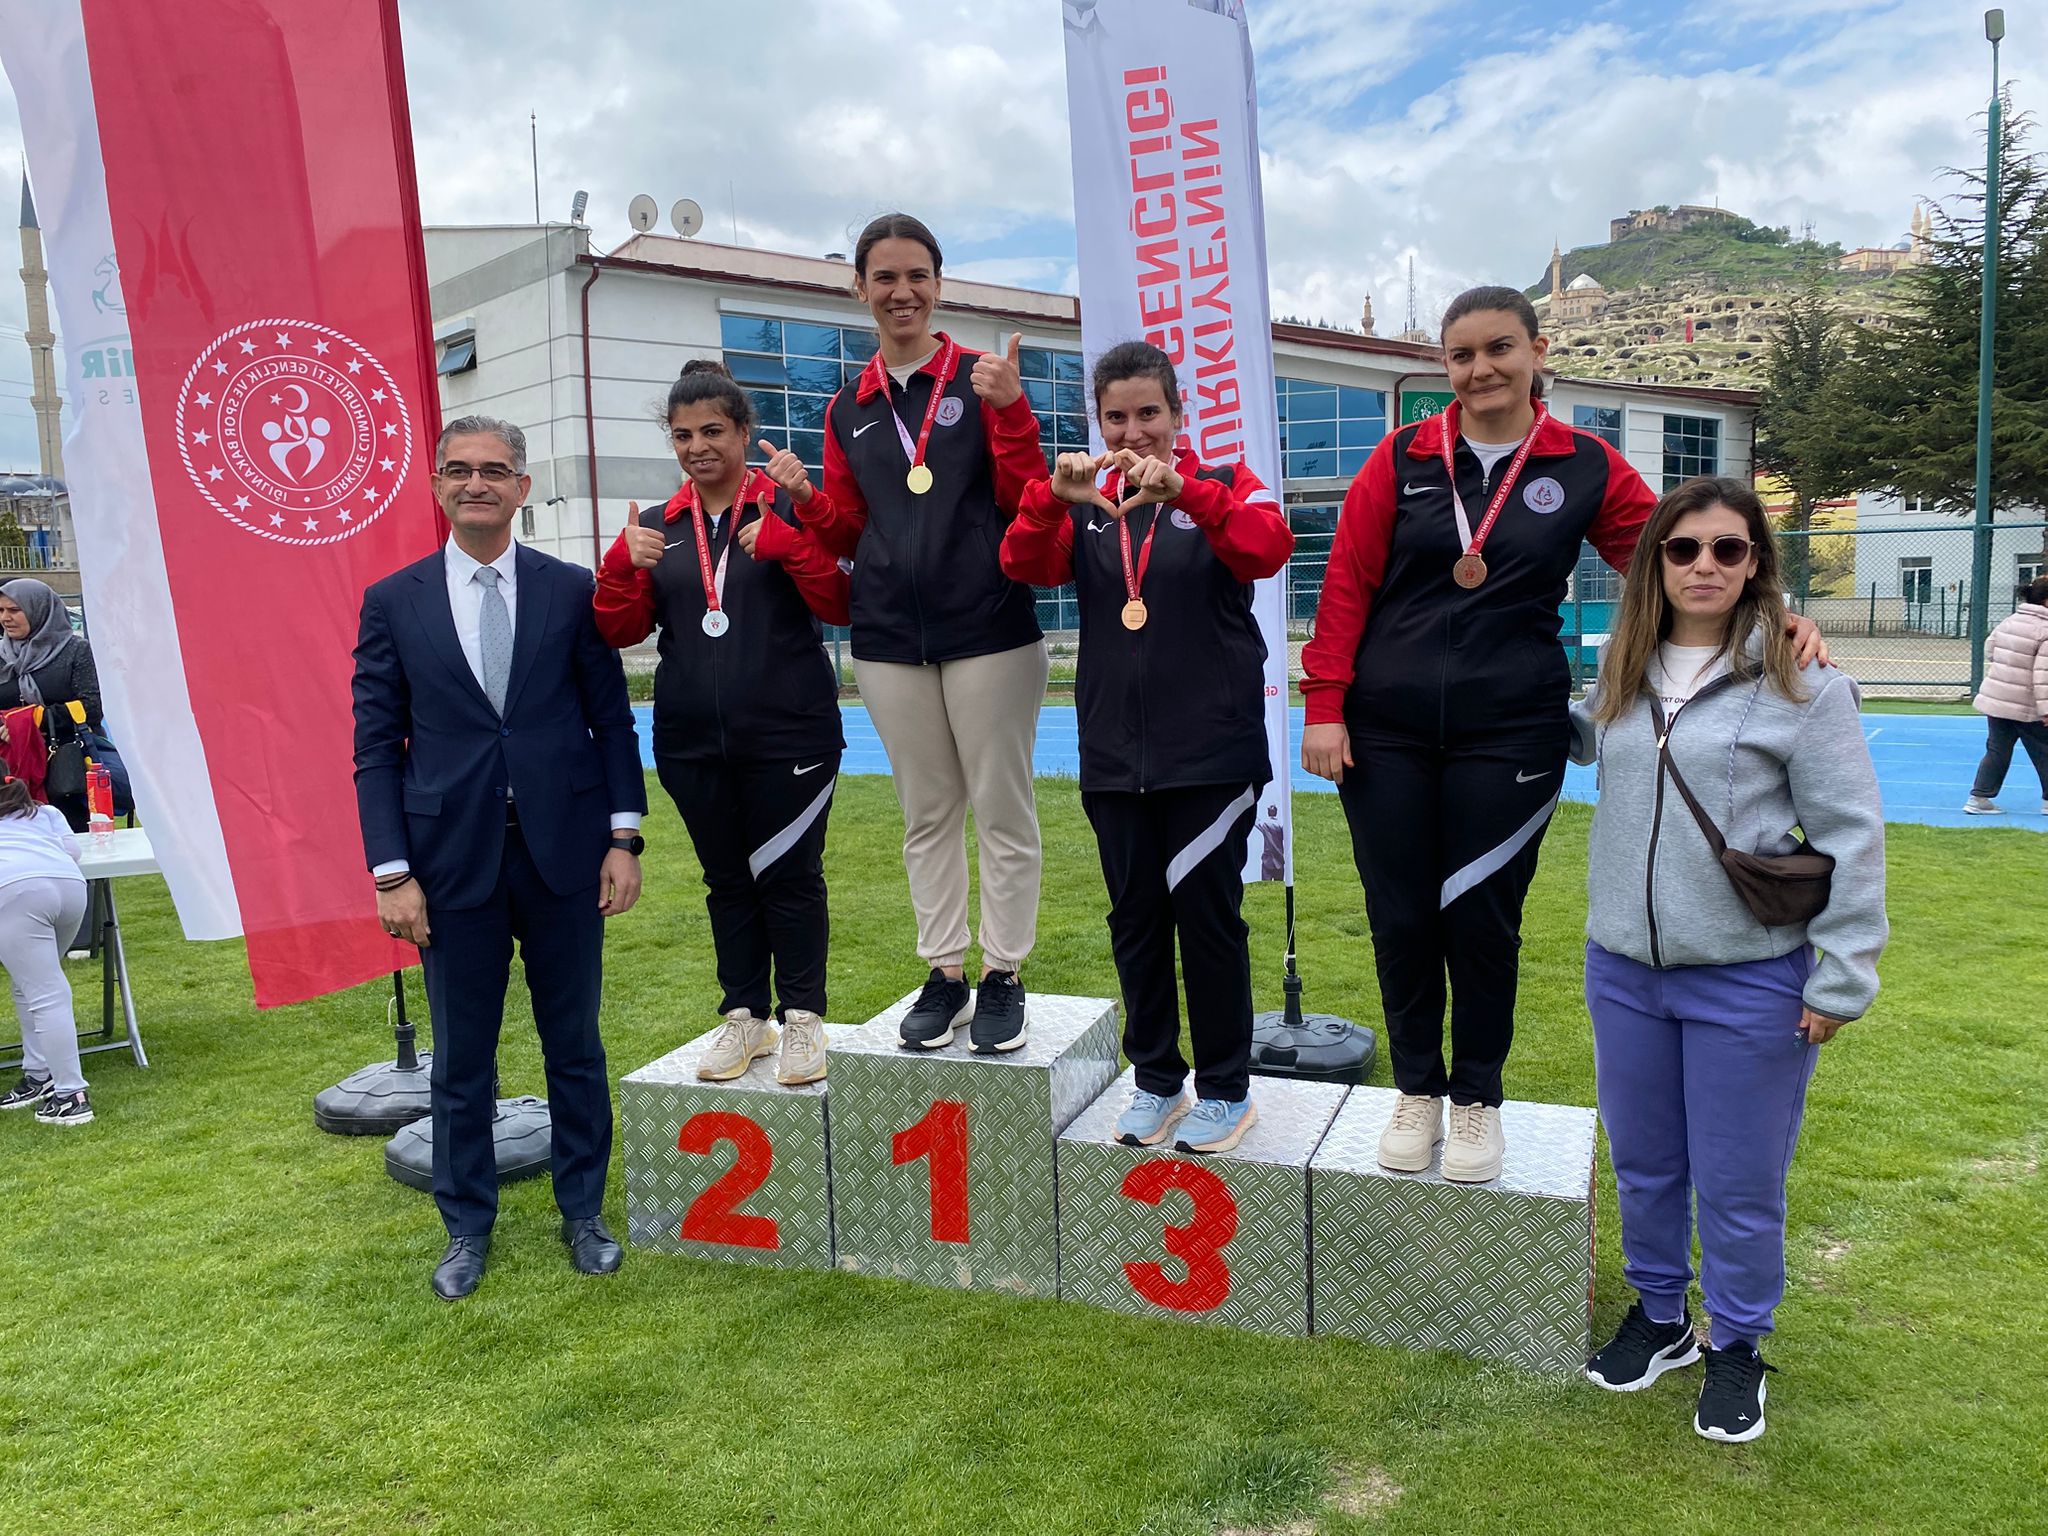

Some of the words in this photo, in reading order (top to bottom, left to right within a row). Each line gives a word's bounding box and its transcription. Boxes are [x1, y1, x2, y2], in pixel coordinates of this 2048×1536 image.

[677, 1111, 779, 1250] 2
[892, 1099, 970, 1244] 1
[1120, 1159, 1239, 1312] 3
